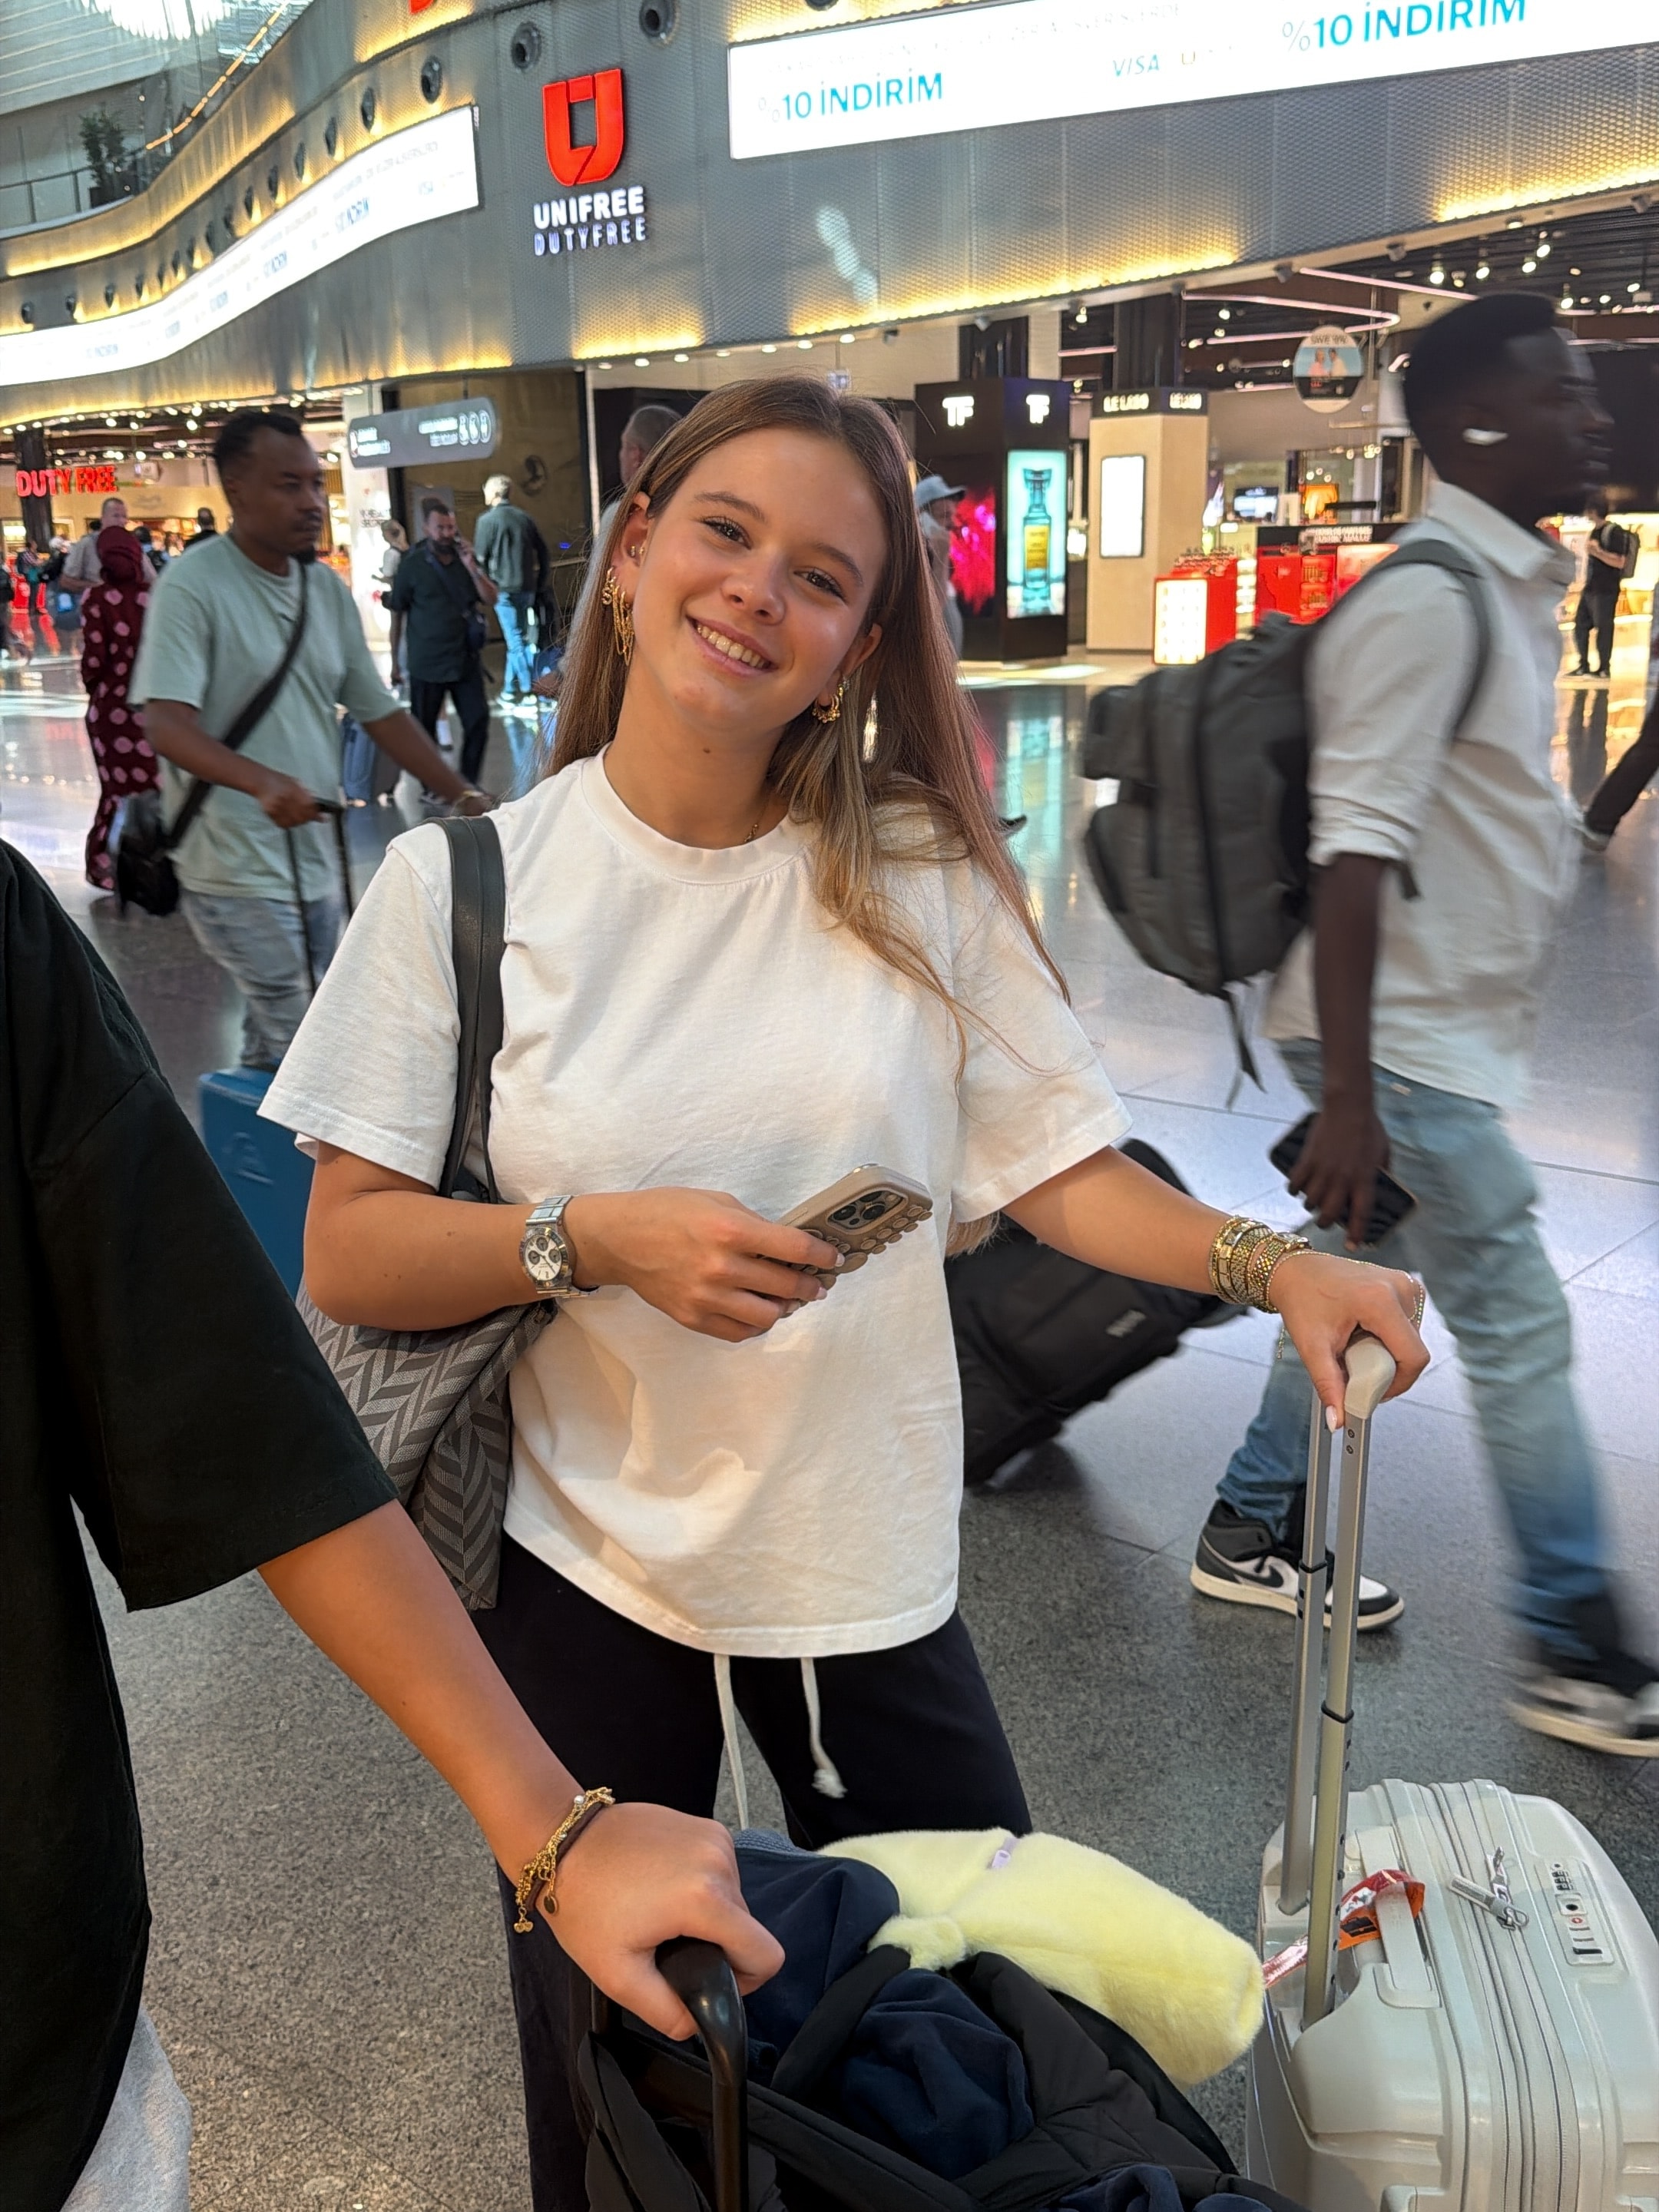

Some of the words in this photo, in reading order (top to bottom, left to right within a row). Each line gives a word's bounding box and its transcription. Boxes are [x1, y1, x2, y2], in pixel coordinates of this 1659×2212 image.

[1112, 53, 1159, 77] VISA
[821, 67, 942, 116] İNDİRİM
[533, 185, 644, 229] UNIFREE
[534, 216, 647, 256] DUTYFREE
[15, 468, 71, 497] DUTY
[75, 465, 118, 494] FREE
